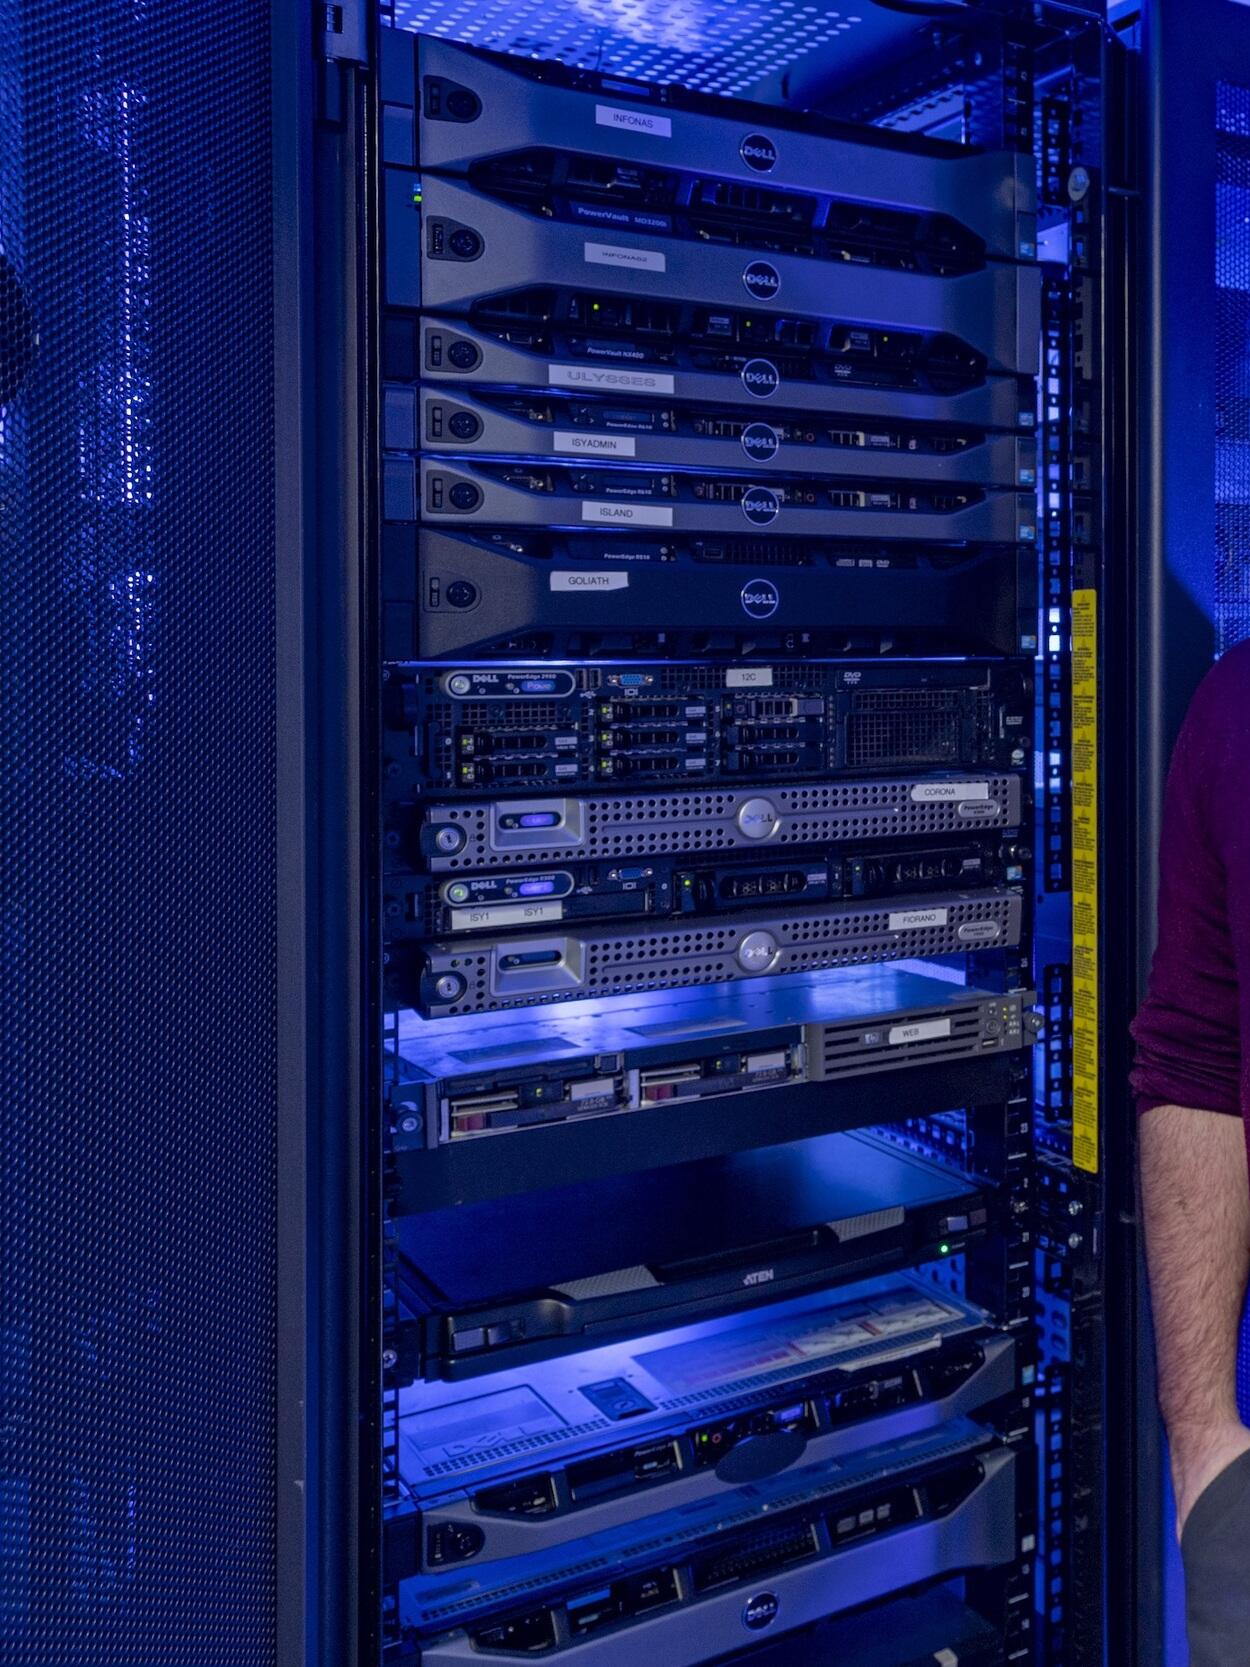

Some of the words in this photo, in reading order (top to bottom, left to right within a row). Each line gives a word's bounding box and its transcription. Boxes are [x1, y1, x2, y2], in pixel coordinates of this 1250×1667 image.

[612, 112, 654, 129] INFONAS
[743, 145, 775, 160] DELL
[577, 207, 630, 222] PowerVault
[746, 273, 778, 287] DELL
[587, 347, 622, 358] PowerVault
[567, 370, 657, 388] ULYSSES
[745, 372, 779, 385] DELL
[571, 438, 617, 449] ISYADMIN
[744, 437, 777, 449] DELL
[745, 500, 777, 512] DELL
[600, 507, 633, 518] ISLAND
[568, 576, 610, 586] GOLIATH
[744, 593, 776, 604] DELL
[472, 674, 499, 683] DELL
[924, 787, 956, 796] CORONA
[471, 880, 498, 890] DELL
[524, 907, 544, 917] ISY1
[902, 913, 937, 924] FIORANO
[902, 1028, 920, 1038] WEB
[742, 1268, 774, 1286] ATEN
